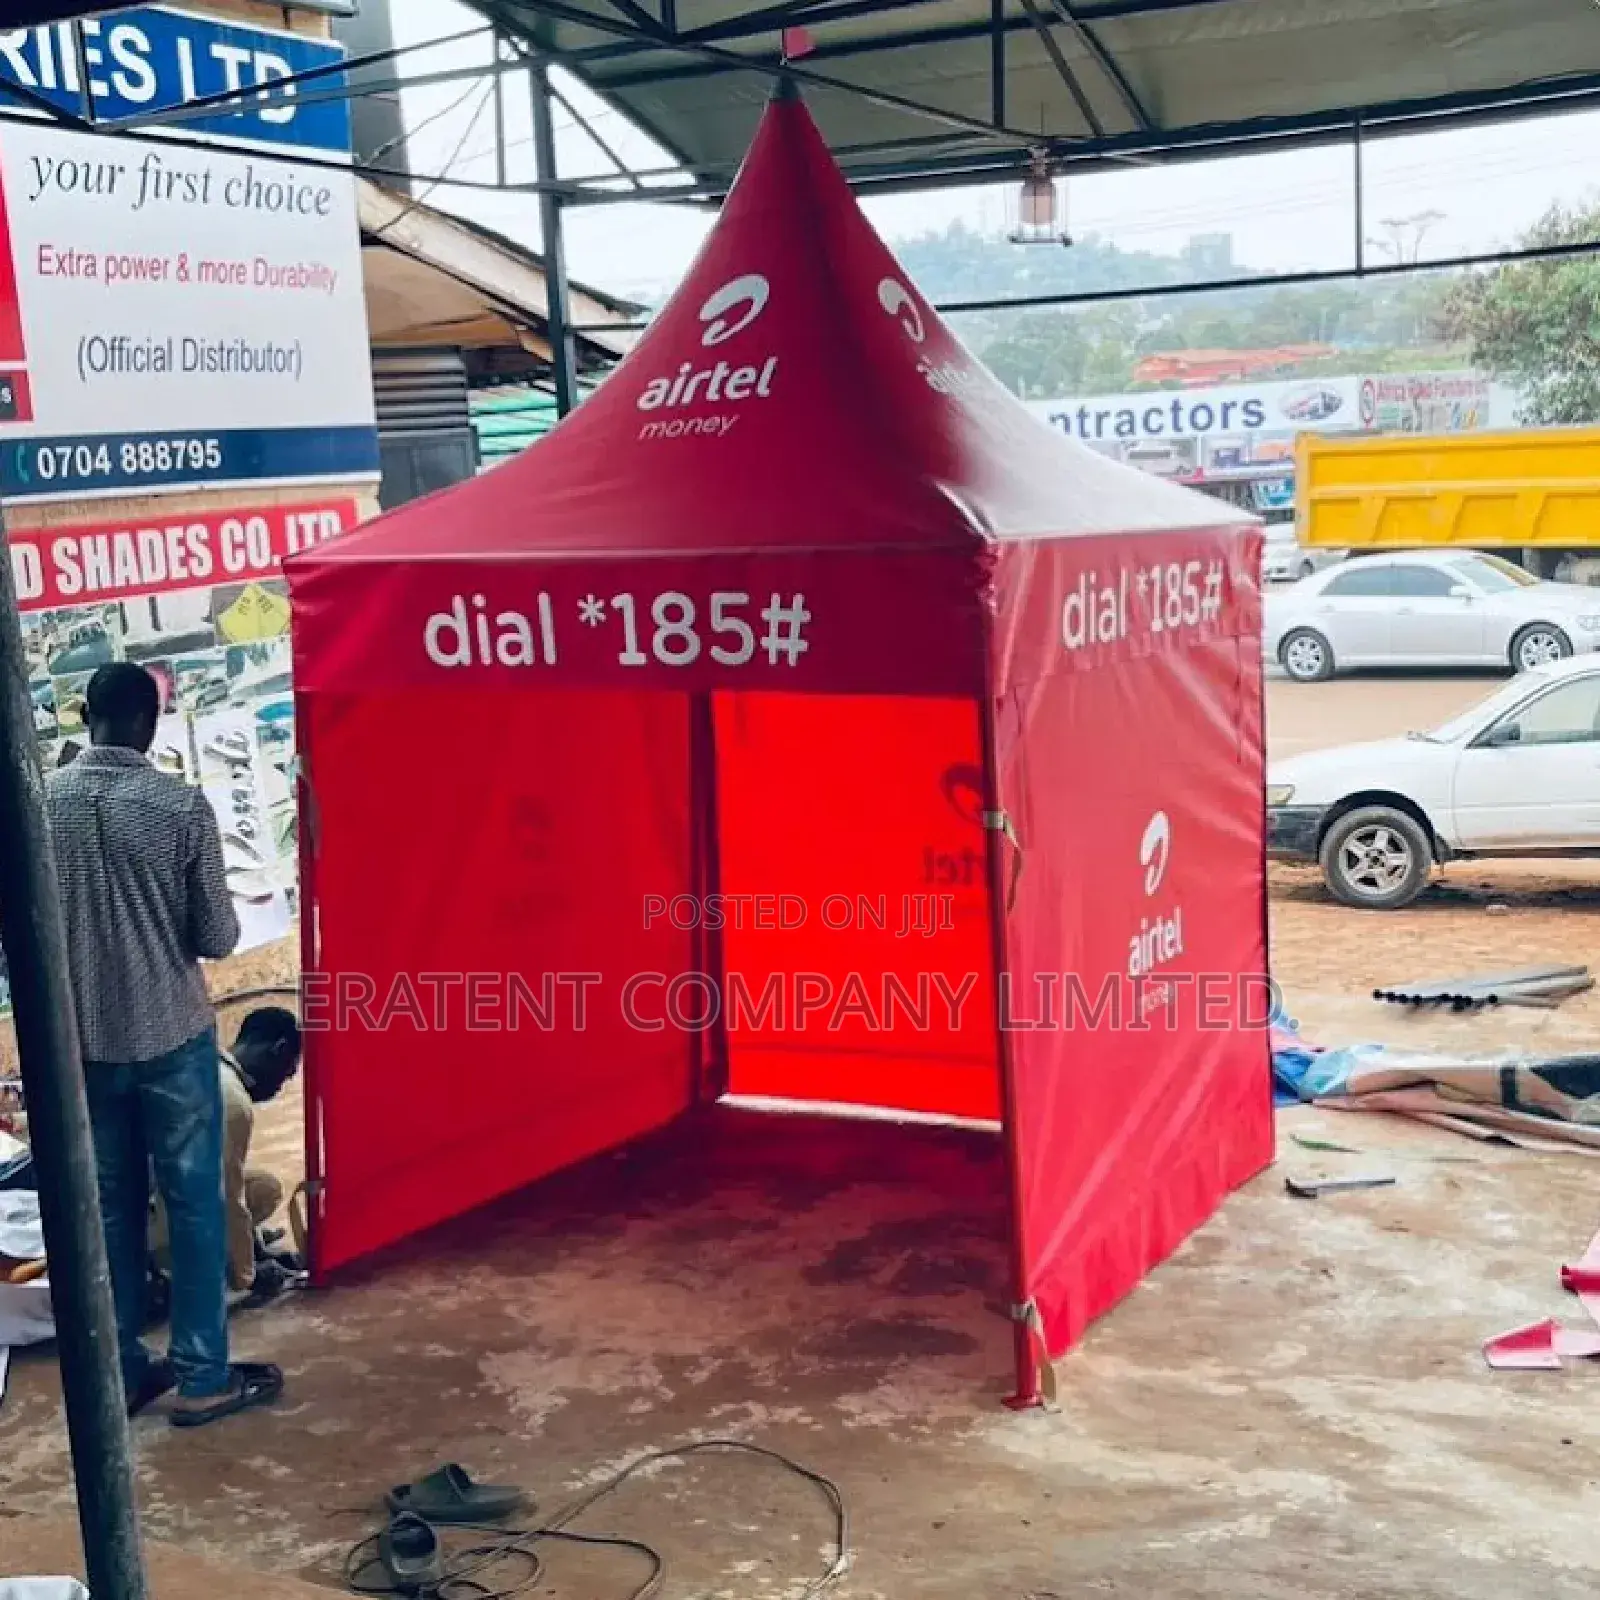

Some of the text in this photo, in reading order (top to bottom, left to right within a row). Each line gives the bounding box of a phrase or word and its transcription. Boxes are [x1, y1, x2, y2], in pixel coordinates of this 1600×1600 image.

[29, 151, 331, 217] your first choice
[37, 244, 338, 294] Extra power & more Durability
[77, 335, 303, 382] (Official Distributor)
[636, 355, 779, 412] airtel
[637, 412, 740, 441] money
[37, 438, 222, 480] 0704 888795
[52, 522, 214, 596] SHADES
[219, 516, 282, 574] CO.
[423, 591, 557, 668] dial
[1063, 564, 1127, 649] dial
[1129, 905, 1184, 977] airtel
